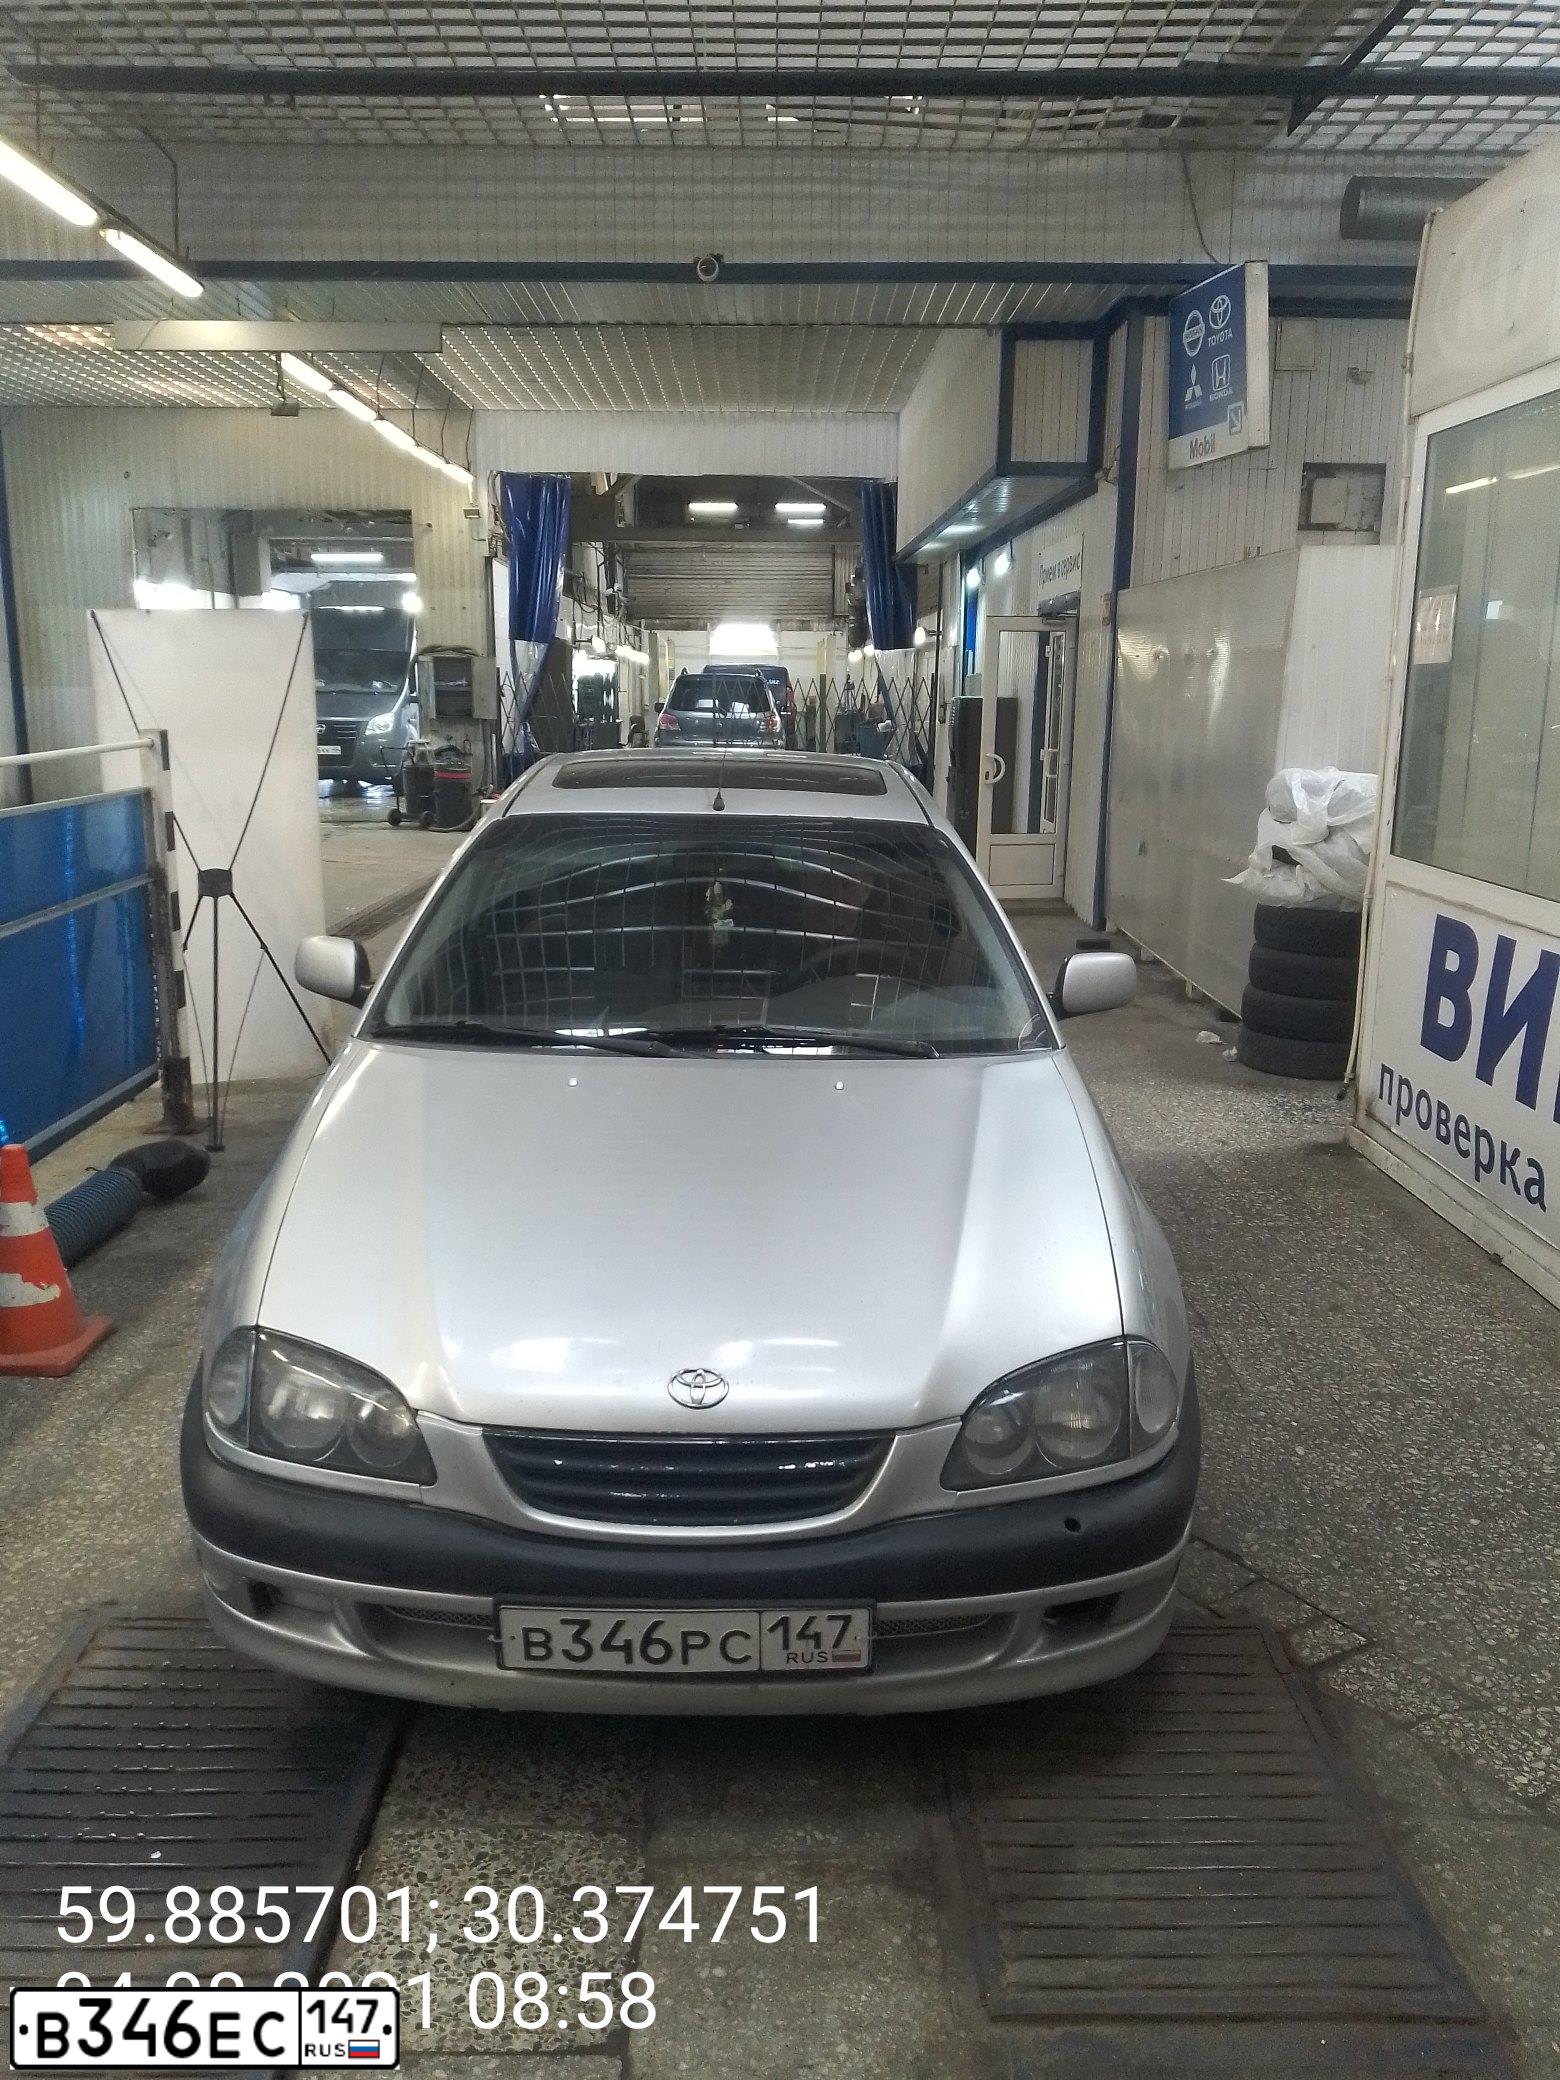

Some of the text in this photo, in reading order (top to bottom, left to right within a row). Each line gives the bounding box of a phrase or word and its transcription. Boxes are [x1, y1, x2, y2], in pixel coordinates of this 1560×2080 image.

[1207, 327, 1233, 348] TOYOTA
[1189, 432, 1216, 460] Mobil
[1420, 913, 1560, 1122] ВИ
[1378, 1062, 1547, 1214] проверка
[766, 1613, 852, 1651] 147
[785, 1650, 829, 1665] RUS
